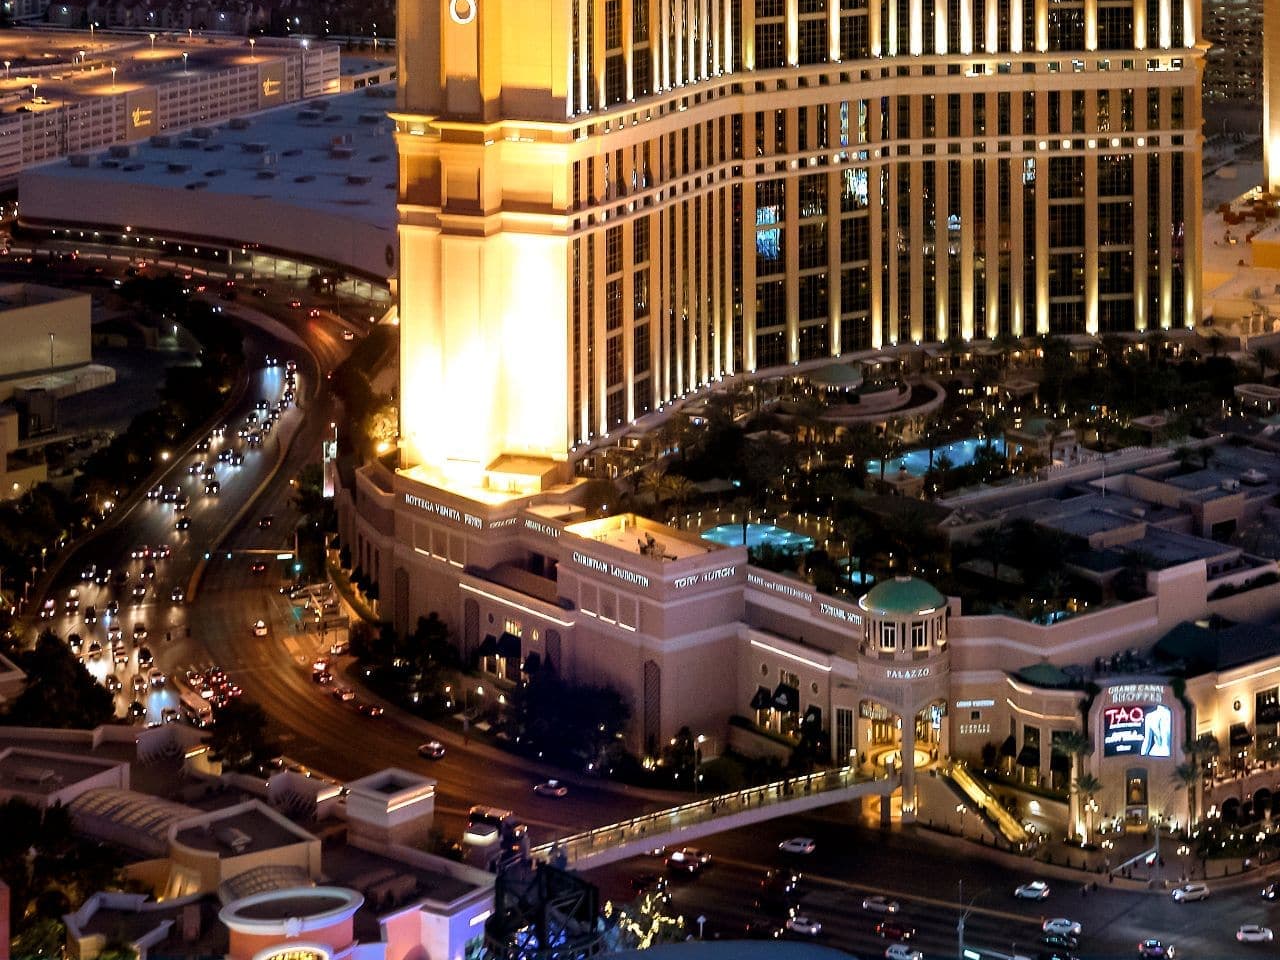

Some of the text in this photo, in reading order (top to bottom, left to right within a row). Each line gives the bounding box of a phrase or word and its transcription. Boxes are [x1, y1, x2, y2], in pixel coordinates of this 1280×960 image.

[572, 551, 608, 575] CHRISTIAN
[674, 575, 699, 589] TORY
[886, 668, 930, 679] PALAZZO
[1105, 707, 1143, 725] TAO
